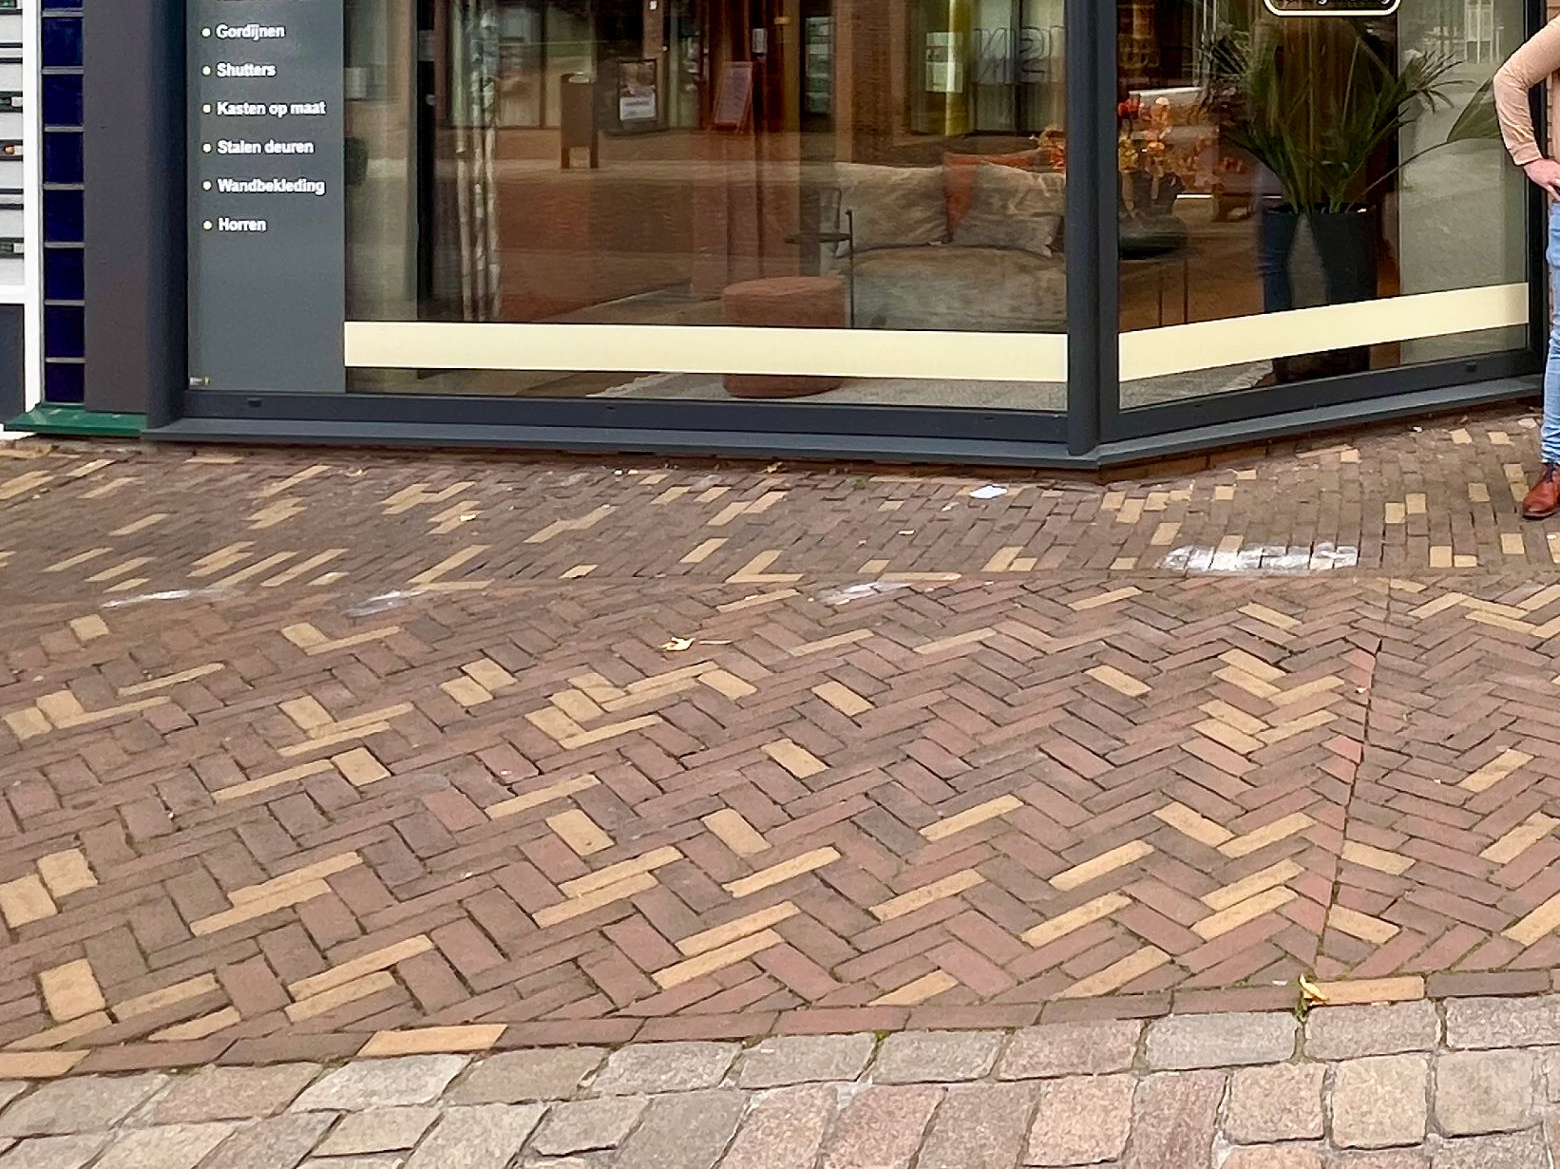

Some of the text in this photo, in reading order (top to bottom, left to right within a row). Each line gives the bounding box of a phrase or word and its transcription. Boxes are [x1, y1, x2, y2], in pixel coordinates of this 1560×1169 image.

[216, 23, 286, 40] Gordijnen
[216, 62, 277, 77] Shutters
[216, 100, 327, 118] Kasten op maat
[217, 139, 315, 154] Stalen deuren
[217, 178, 326, 196] Wandbekleding
[218, 217, 267, 232] Horren
